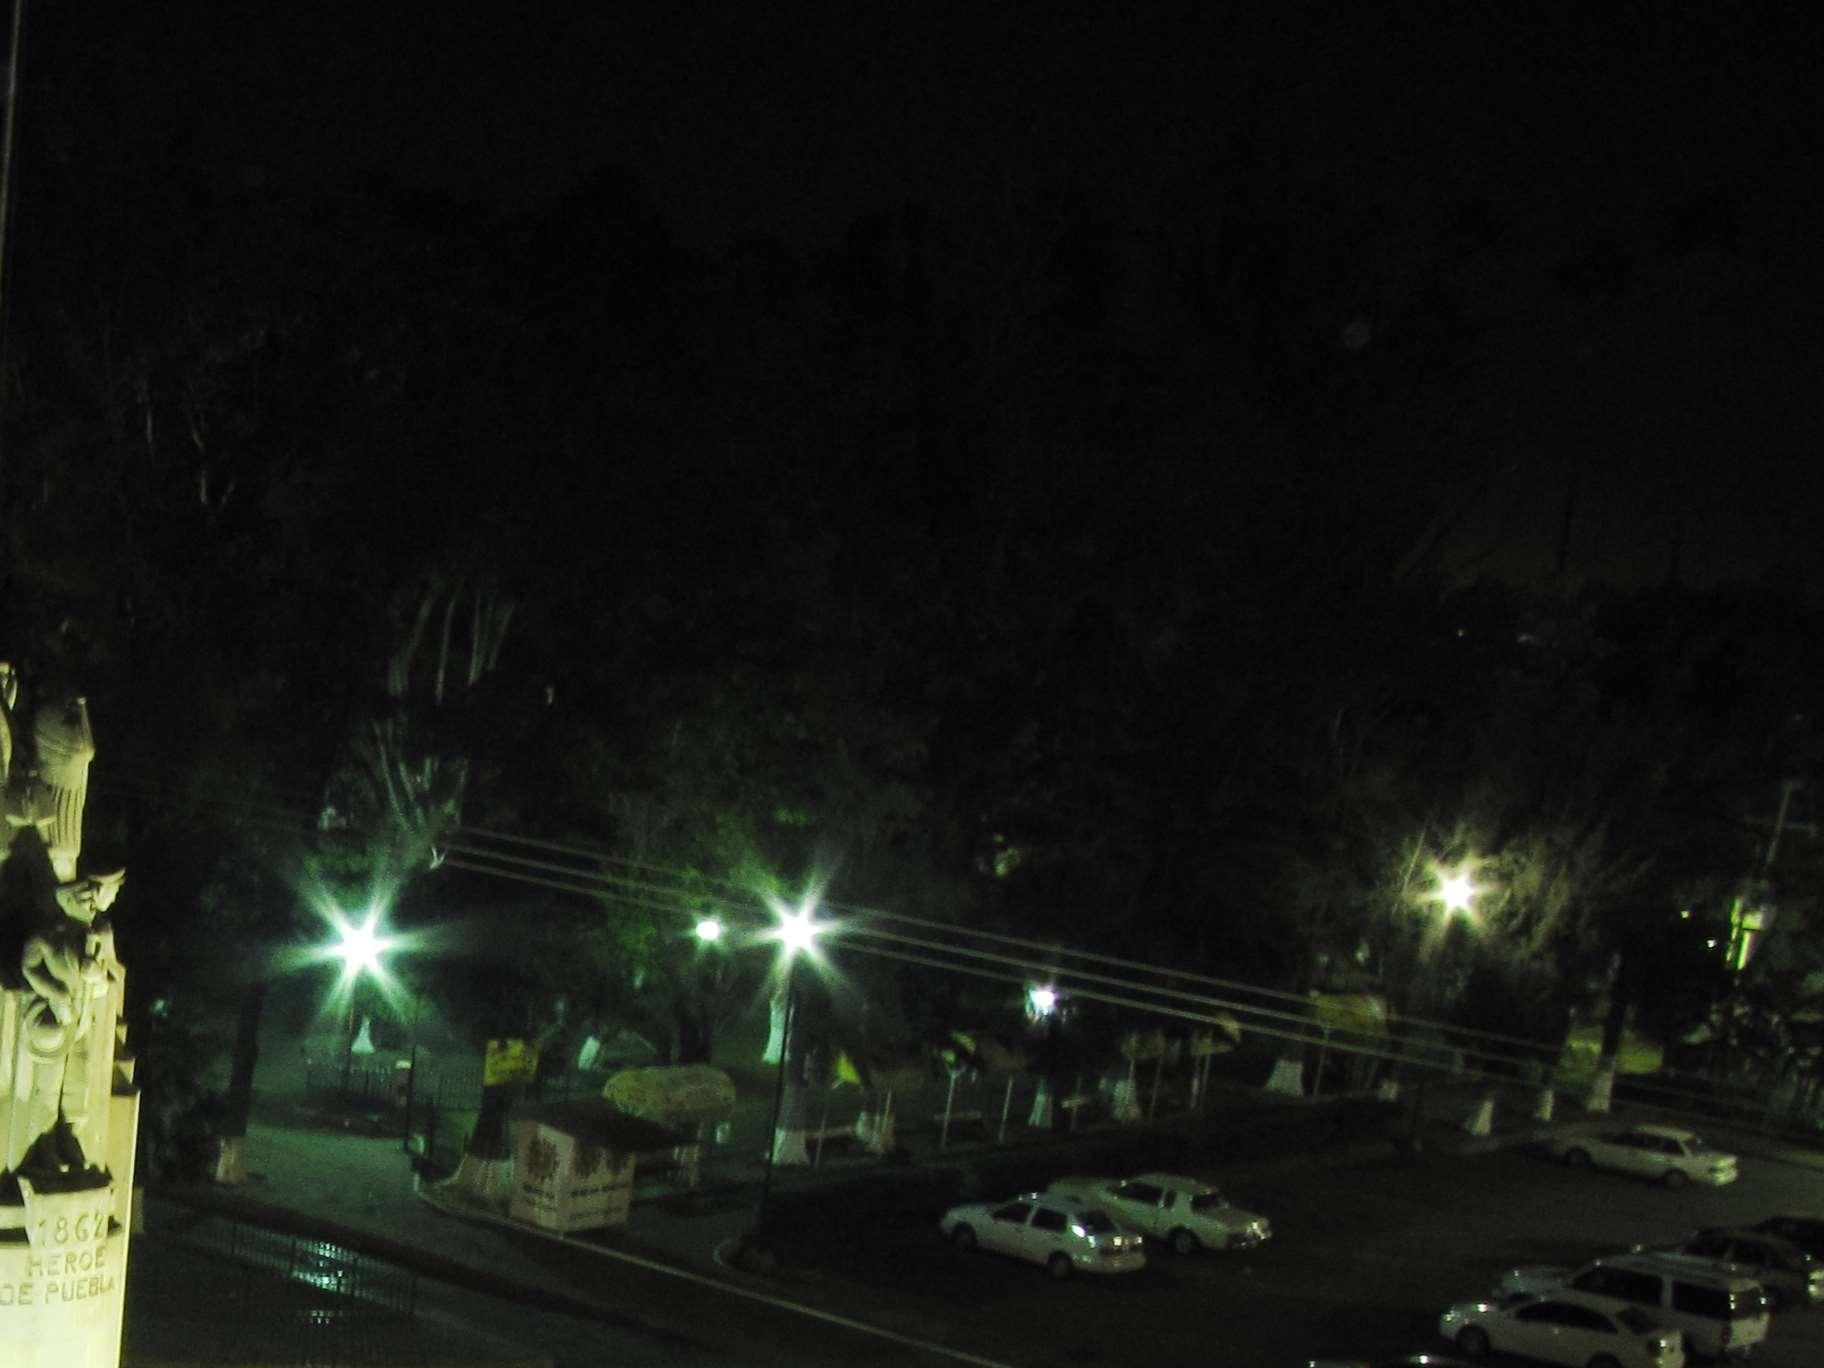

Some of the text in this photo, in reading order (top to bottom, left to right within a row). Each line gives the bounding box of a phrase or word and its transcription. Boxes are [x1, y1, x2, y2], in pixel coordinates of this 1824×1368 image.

[27, 1246, 108, 1278] HEROE
[0, 1274, 117, 1306] DE PUEBLA
